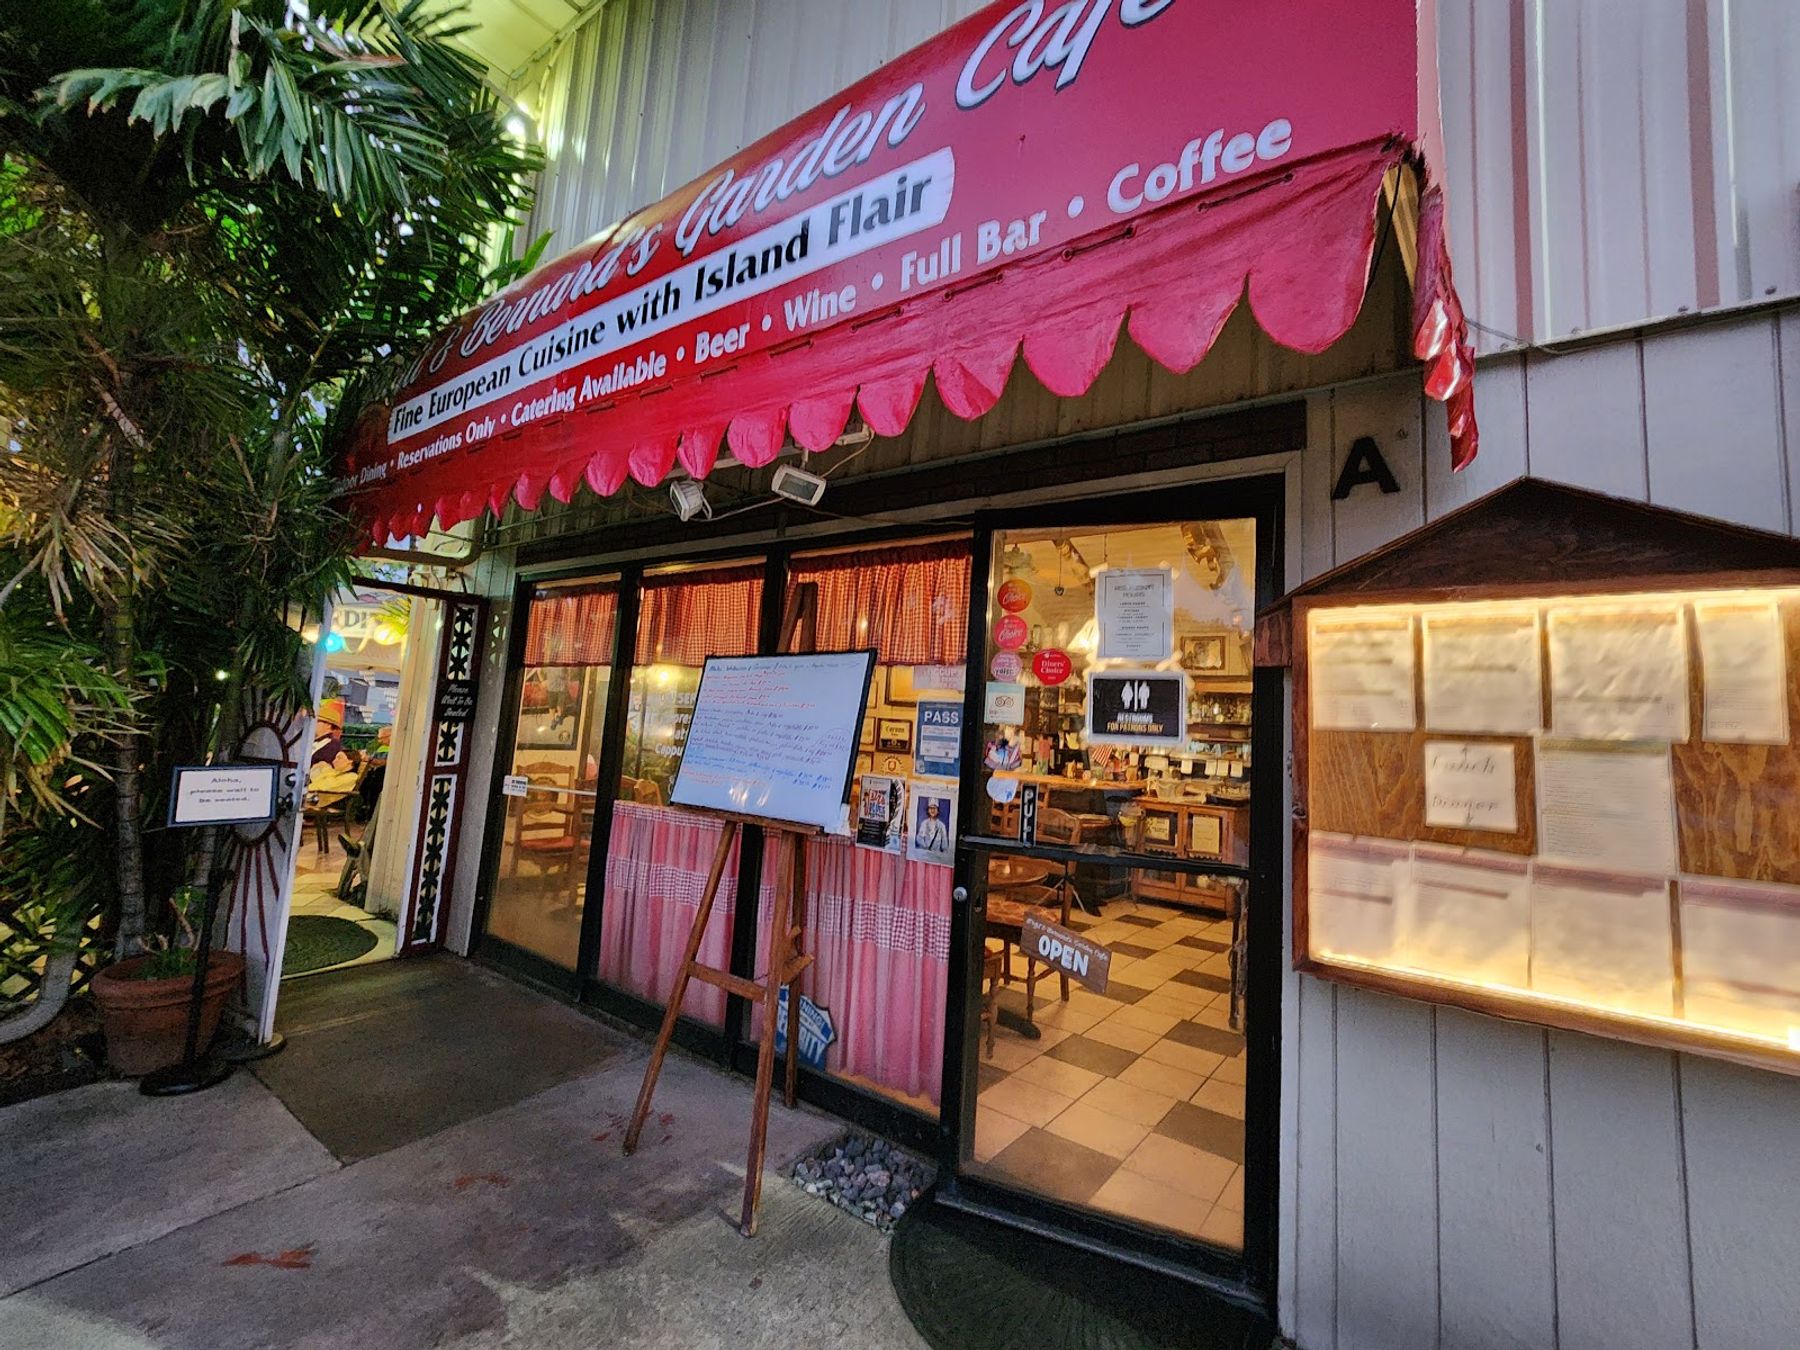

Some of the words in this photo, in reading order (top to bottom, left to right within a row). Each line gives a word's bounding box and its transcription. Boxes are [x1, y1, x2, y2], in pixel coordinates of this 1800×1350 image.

[460, 223, 663, 357] Bernard's
[674, 82, 927, 259] Garden
[360, 461, 388, 484] Dining
[397, 431, 462, 470] Reservations
[465, 415, 497, 444] Only
[511, 386, 577, 427] Catering
[578, 351, 668, 403] Available
[694, 322, 750, 364] Beer
[784, 284, 857, 332] Wine
[900, 233, 962, 293] Full
[977, 209, 1047, 265] Bar
[1107, 118, 1293, 214] Coffee
[393, 405, 424, 434] Fine
[428, 364, 511, 420] European
[518, 321, 606, 377] Cuisine
[617, 280, 681, 334] with
[695, 217, 810, 301] Island
[827, 174, 933, 249] Flair
[1331, 436, 1401, 500] A
[924, 710, 959, 725] PASS
[1038, 935, 1089, 977] OPEN
